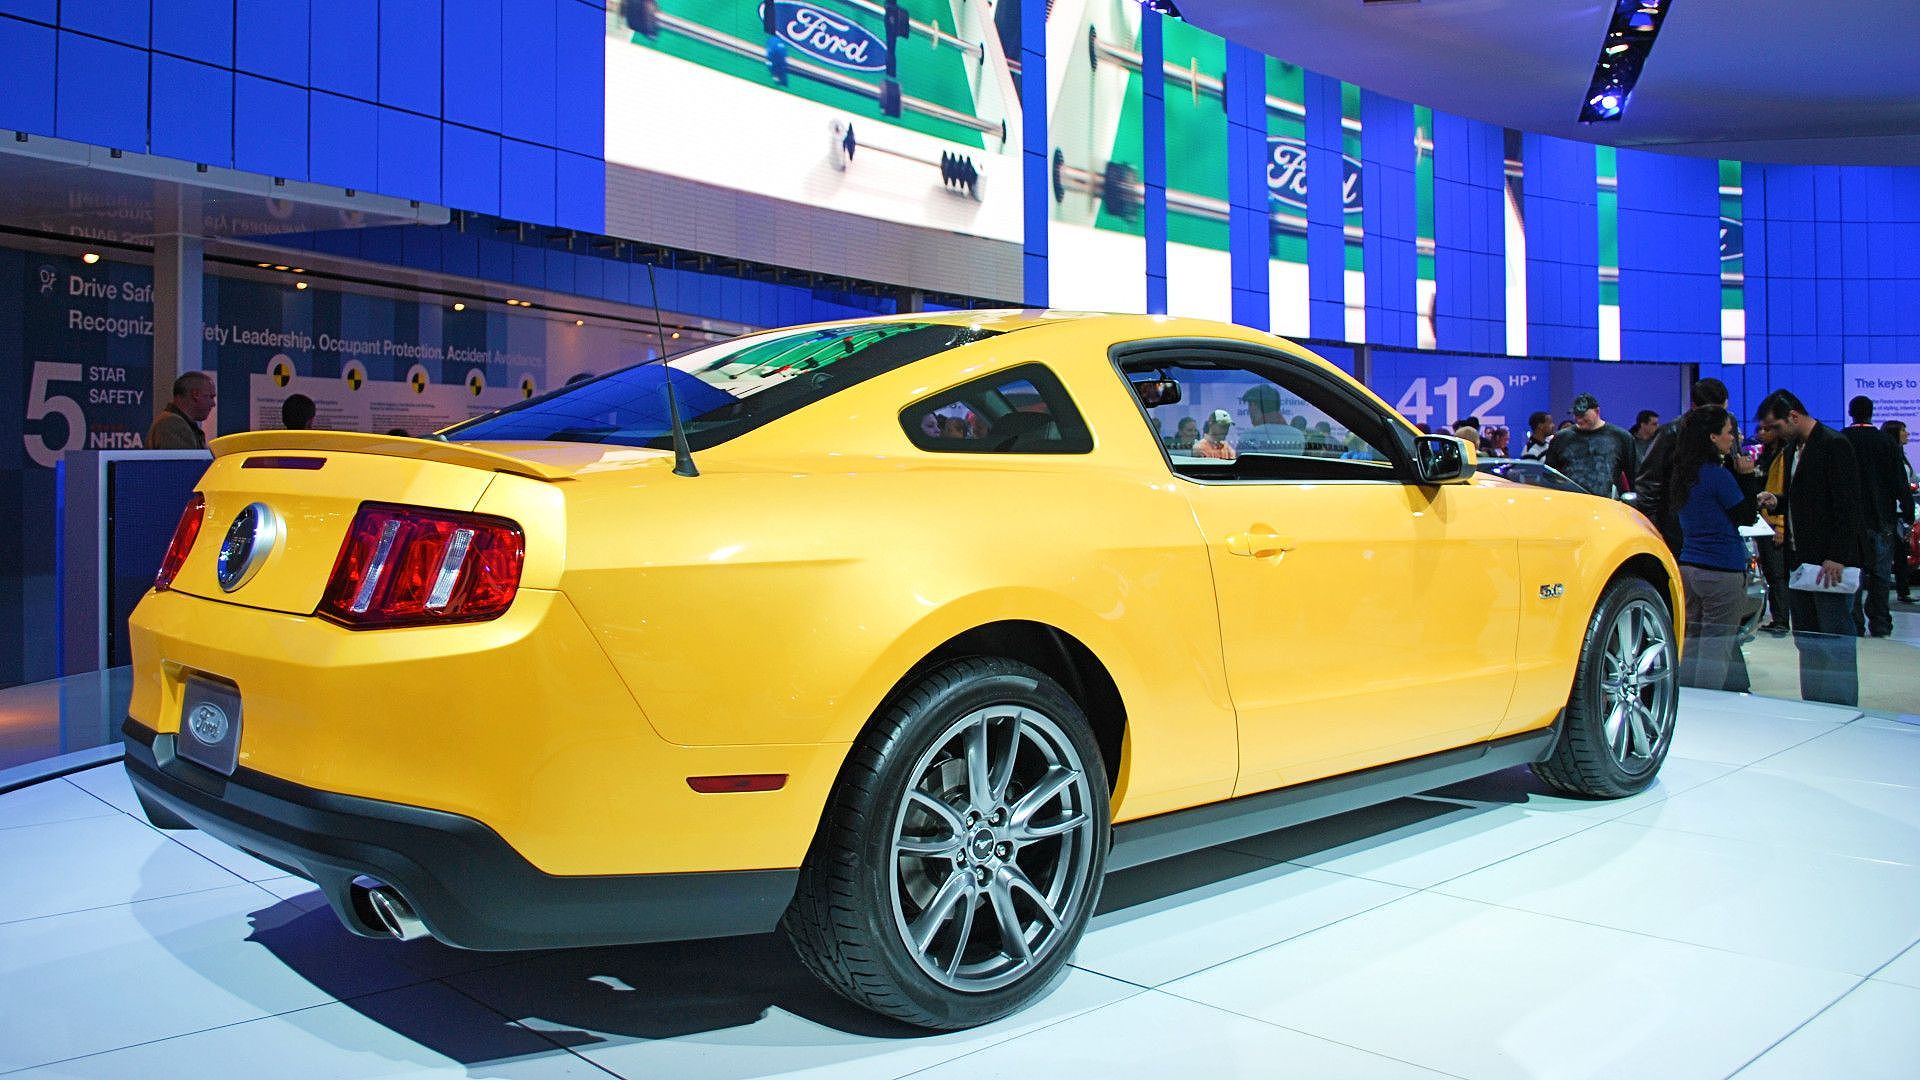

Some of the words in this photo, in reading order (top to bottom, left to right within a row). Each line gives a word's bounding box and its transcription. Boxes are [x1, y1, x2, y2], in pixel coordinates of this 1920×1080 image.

[787, 8, 868, 63] Ford
[69, 275, 118, 299] Drive
[122, 281, 155, 303] Saf
[69, 309, 154, 338] Recogniz
[203, 322, 229, 346] ety
[232, 325, 315, 353] Leadership.
[318, 333, 381, 355] Occupant
[383, 339, 444, 360] Protection.
[447, 346, 492, 364] Accident
[89, 366, 126, 382] STAR
[1855, 378, 1875, 388] The
[1877, 378, 1903, 390] keys
[1906, 379, 1917, 388] to
[89, 388, 144, 405] SAFETY
[1396, 375, 1505, 426] 412
[24, 361, 87, 468] 5
[90, 431, 144, 449] NHTSA
[1540, 583, 1565, 599] 5.0
